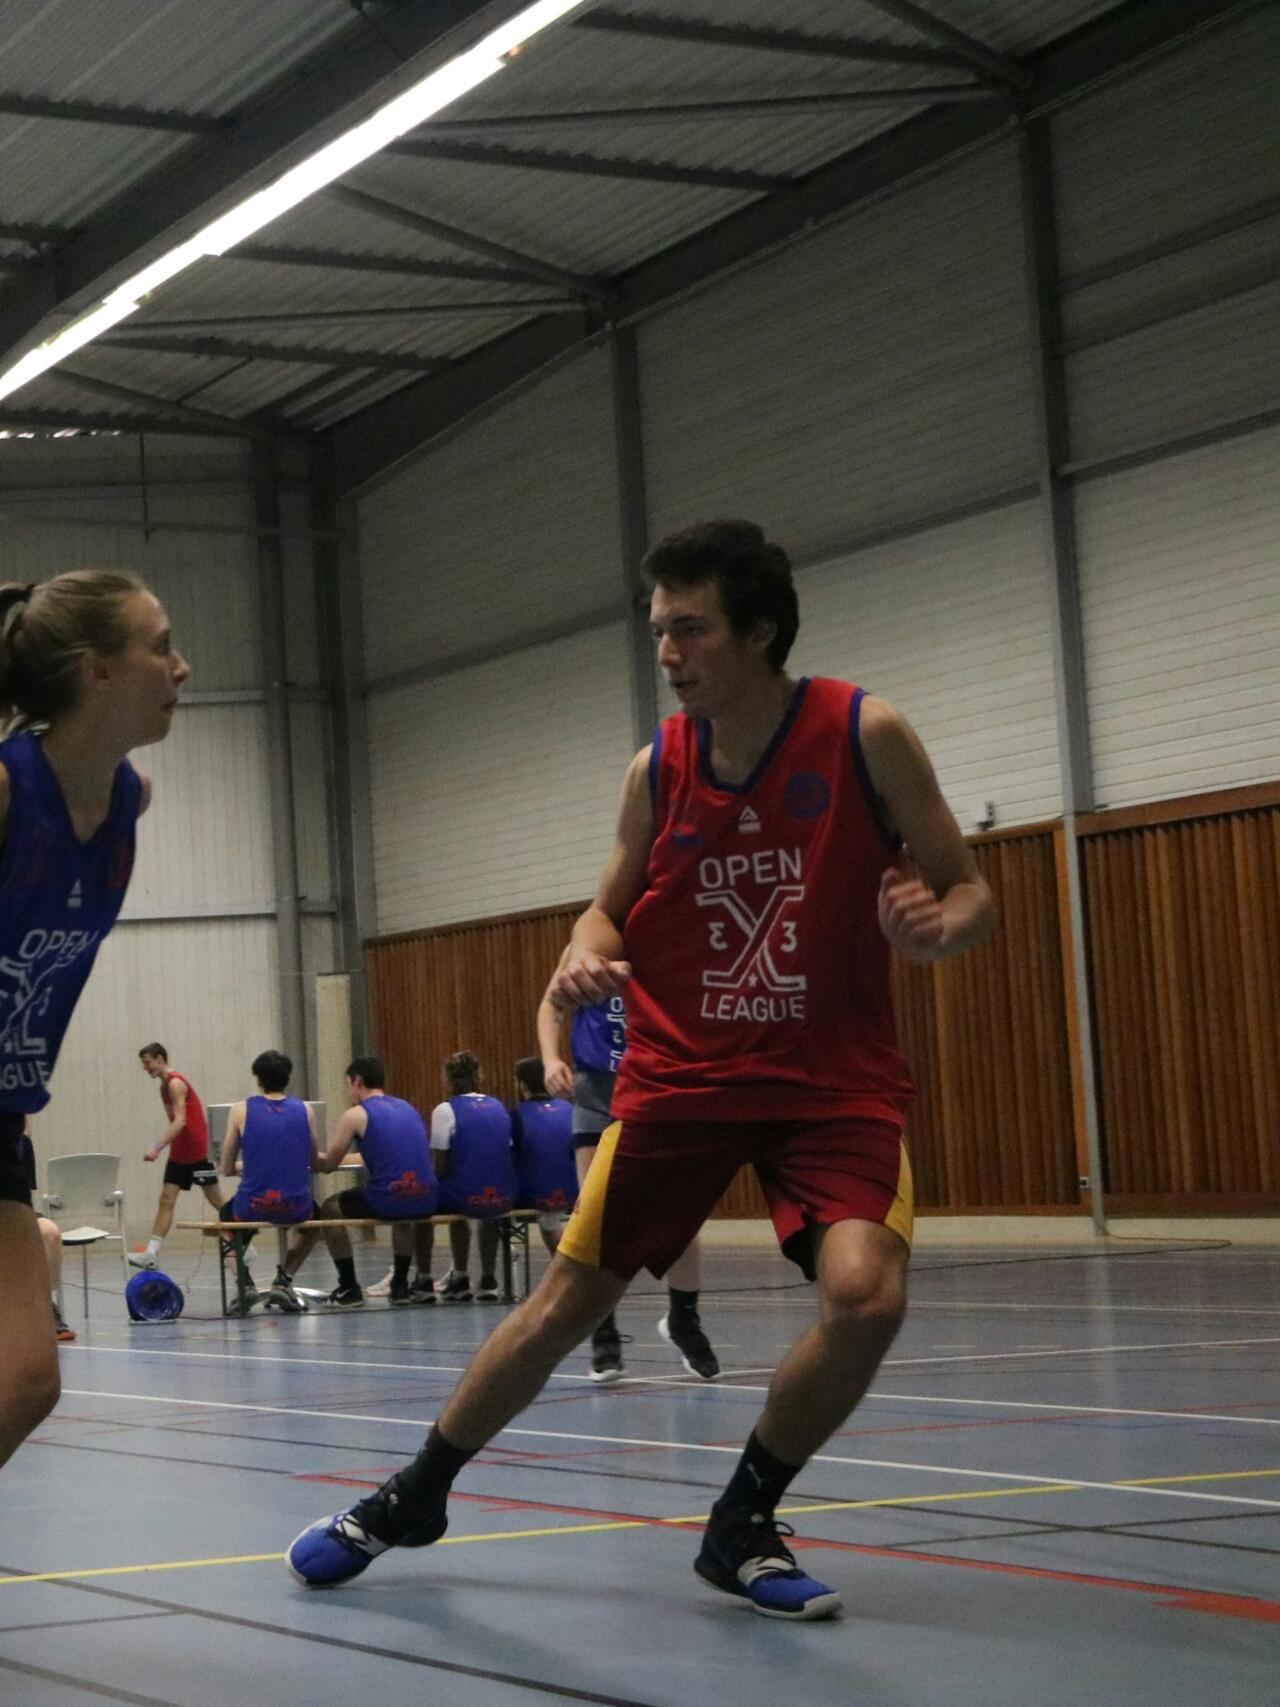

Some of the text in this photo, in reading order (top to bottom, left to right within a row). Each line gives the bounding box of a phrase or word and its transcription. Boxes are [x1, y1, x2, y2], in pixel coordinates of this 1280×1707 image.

[699, 847, 802, 889] OPEN
[19, 928, 100, 960] OPEN
[700, 993, 806, 1023] LEAGUE
